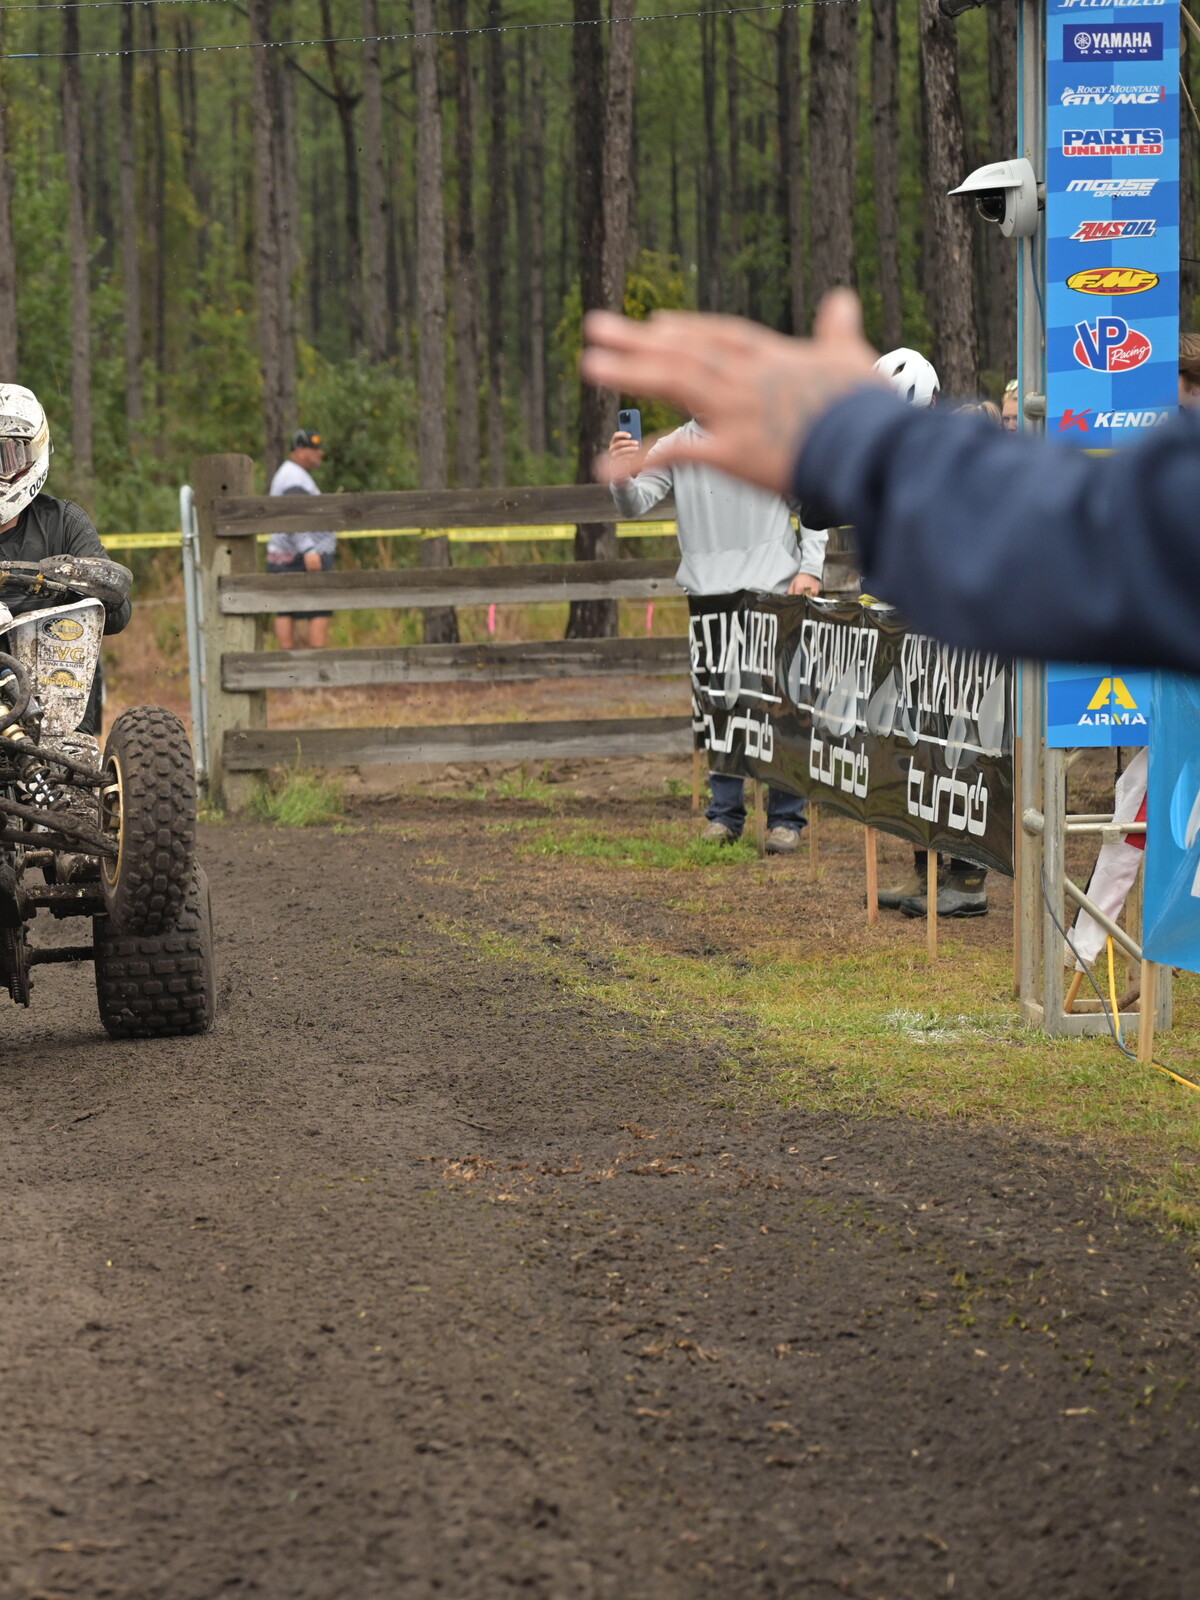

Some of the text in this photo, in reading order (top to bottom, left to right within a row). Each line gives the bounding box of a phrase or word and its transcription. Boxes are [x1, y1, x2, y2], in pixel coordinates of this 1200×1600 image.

[1092, 32, 1152, 48] YAMAHA
[1076, 85, 1160, 94] ROCKY MOUNTAIN
[1063, 129, 1162, 145] PARTS
[1063, 145, 1162, 156] UNLIMITED
[1066, 179, 1159, 191] MOOSE
[1074, 221, 1156, 240] AMSOIL
[1068, 270, 1158, 289] FMF
[1075, 316, 1129, 371] VP
[1111, 345, 1150, 365] Racing
[1094, 412, 1169, 428] KENDA
[1078, 713, 1147, 726] ARMA
[907, 755, 988, 837] turbo
